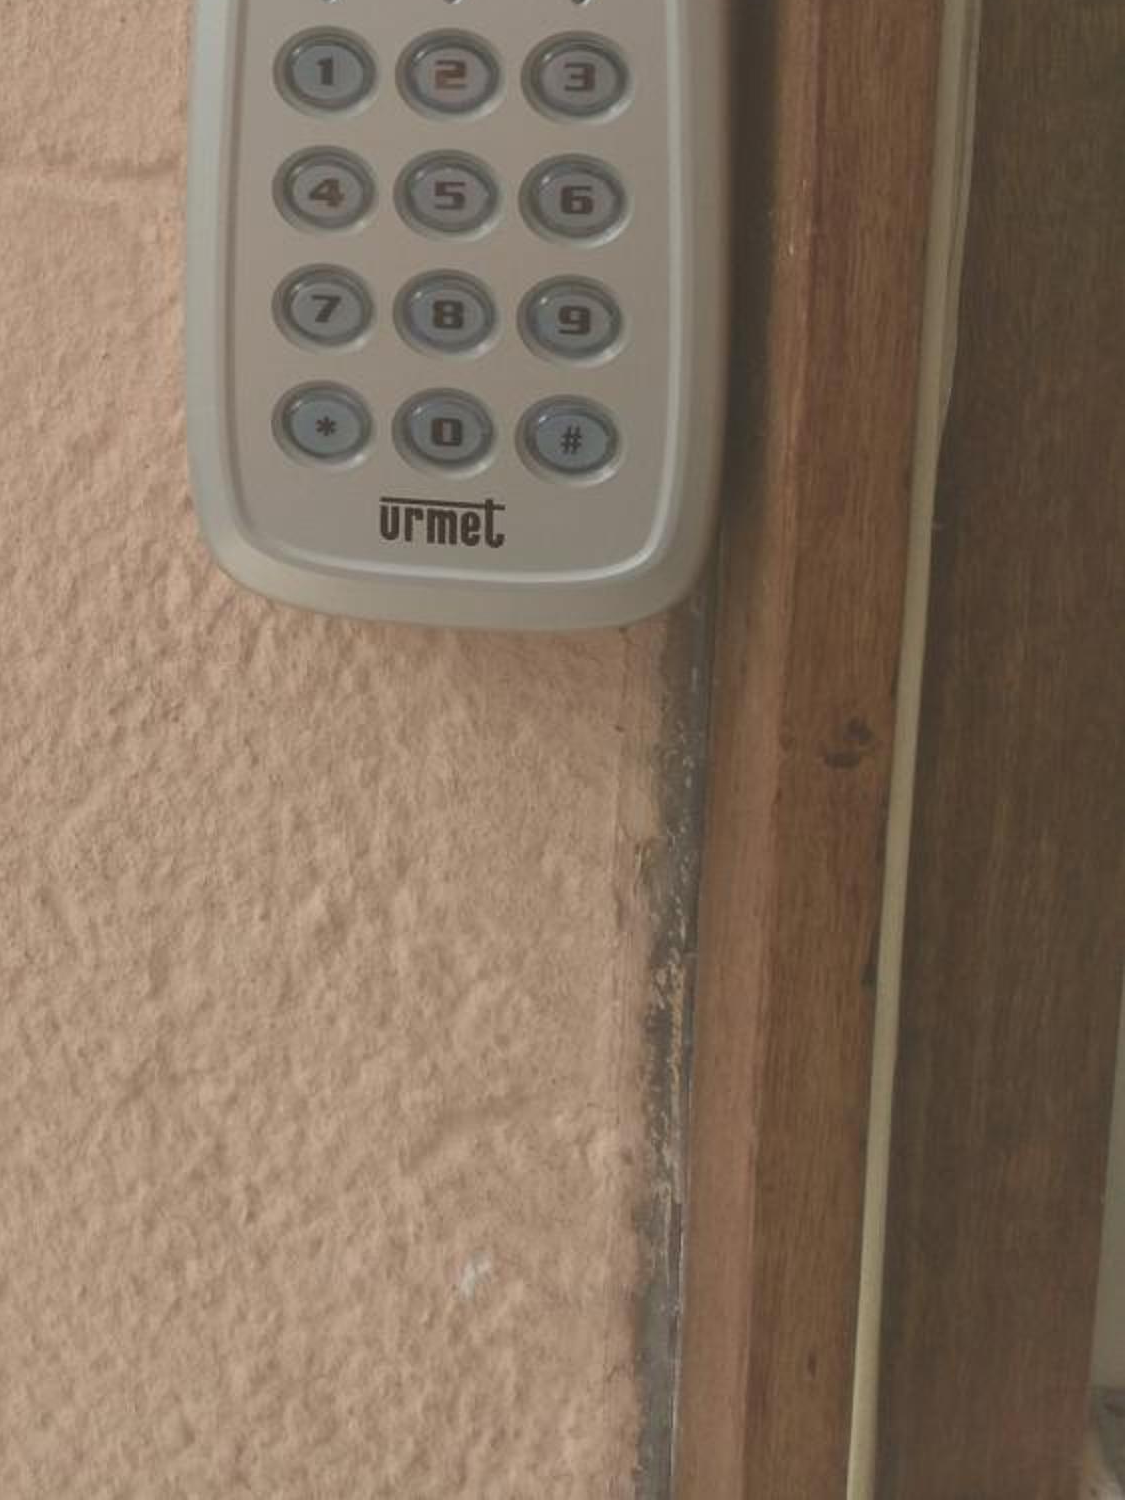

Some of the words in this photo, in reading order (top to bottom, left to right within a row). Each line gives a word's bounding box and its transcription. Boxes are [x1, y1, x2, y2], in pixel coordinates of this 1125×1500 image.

[316, 57, 335, 86] 1
[433, 59, 467, 91] 2
[564, 62, 595, 93] 3
[308, 177, 345, 207] 4
[433, 181, 467, 210] 5
[559, 184, 593, 215] 6
[310, 295, 343, 323] 7
[432, 299, 465, 330] 8
[557, 304, 591, 335] 9
[431, 417, 463, 447] 0
[560, 425, 583, 455] #
[379, 496, 506, 549] urmet
